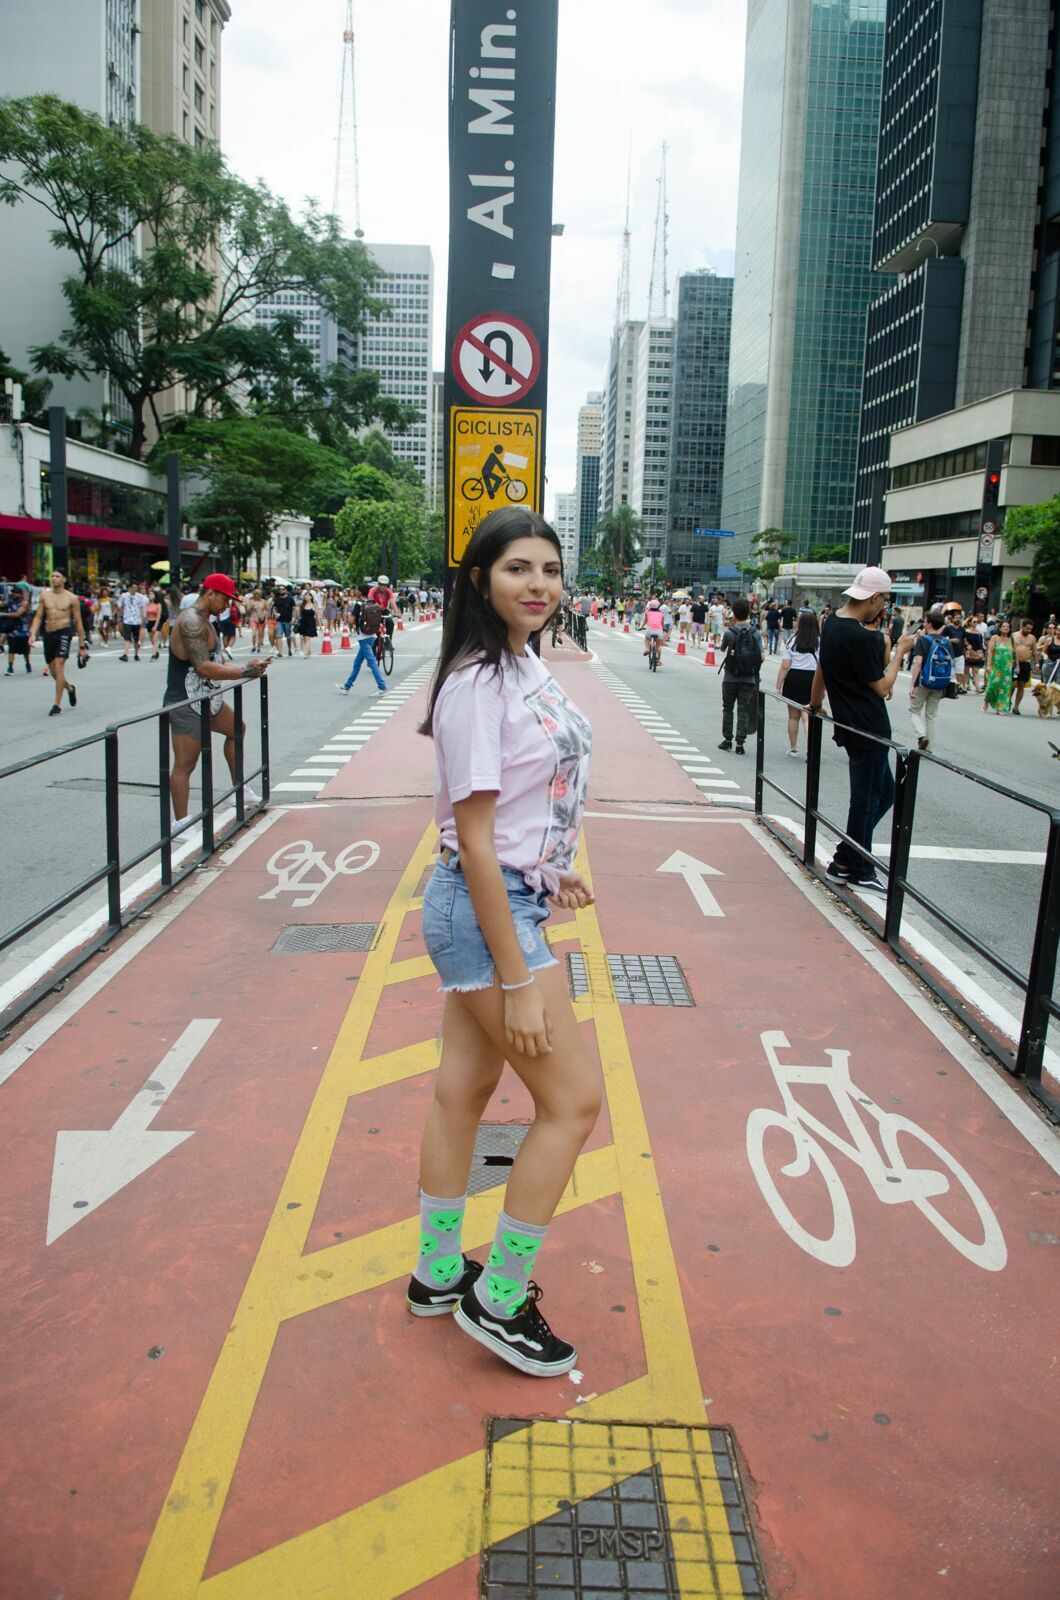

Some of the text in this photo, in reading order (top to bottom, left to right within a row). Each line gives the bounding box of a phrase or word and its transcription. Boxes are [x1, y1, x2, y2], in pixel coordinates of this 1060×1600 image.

[467, 9, 517, 240] Al. Min.
[457, 420, 534, 437] CICLISTA
[577, 1528, 664, 1559] PMSP
